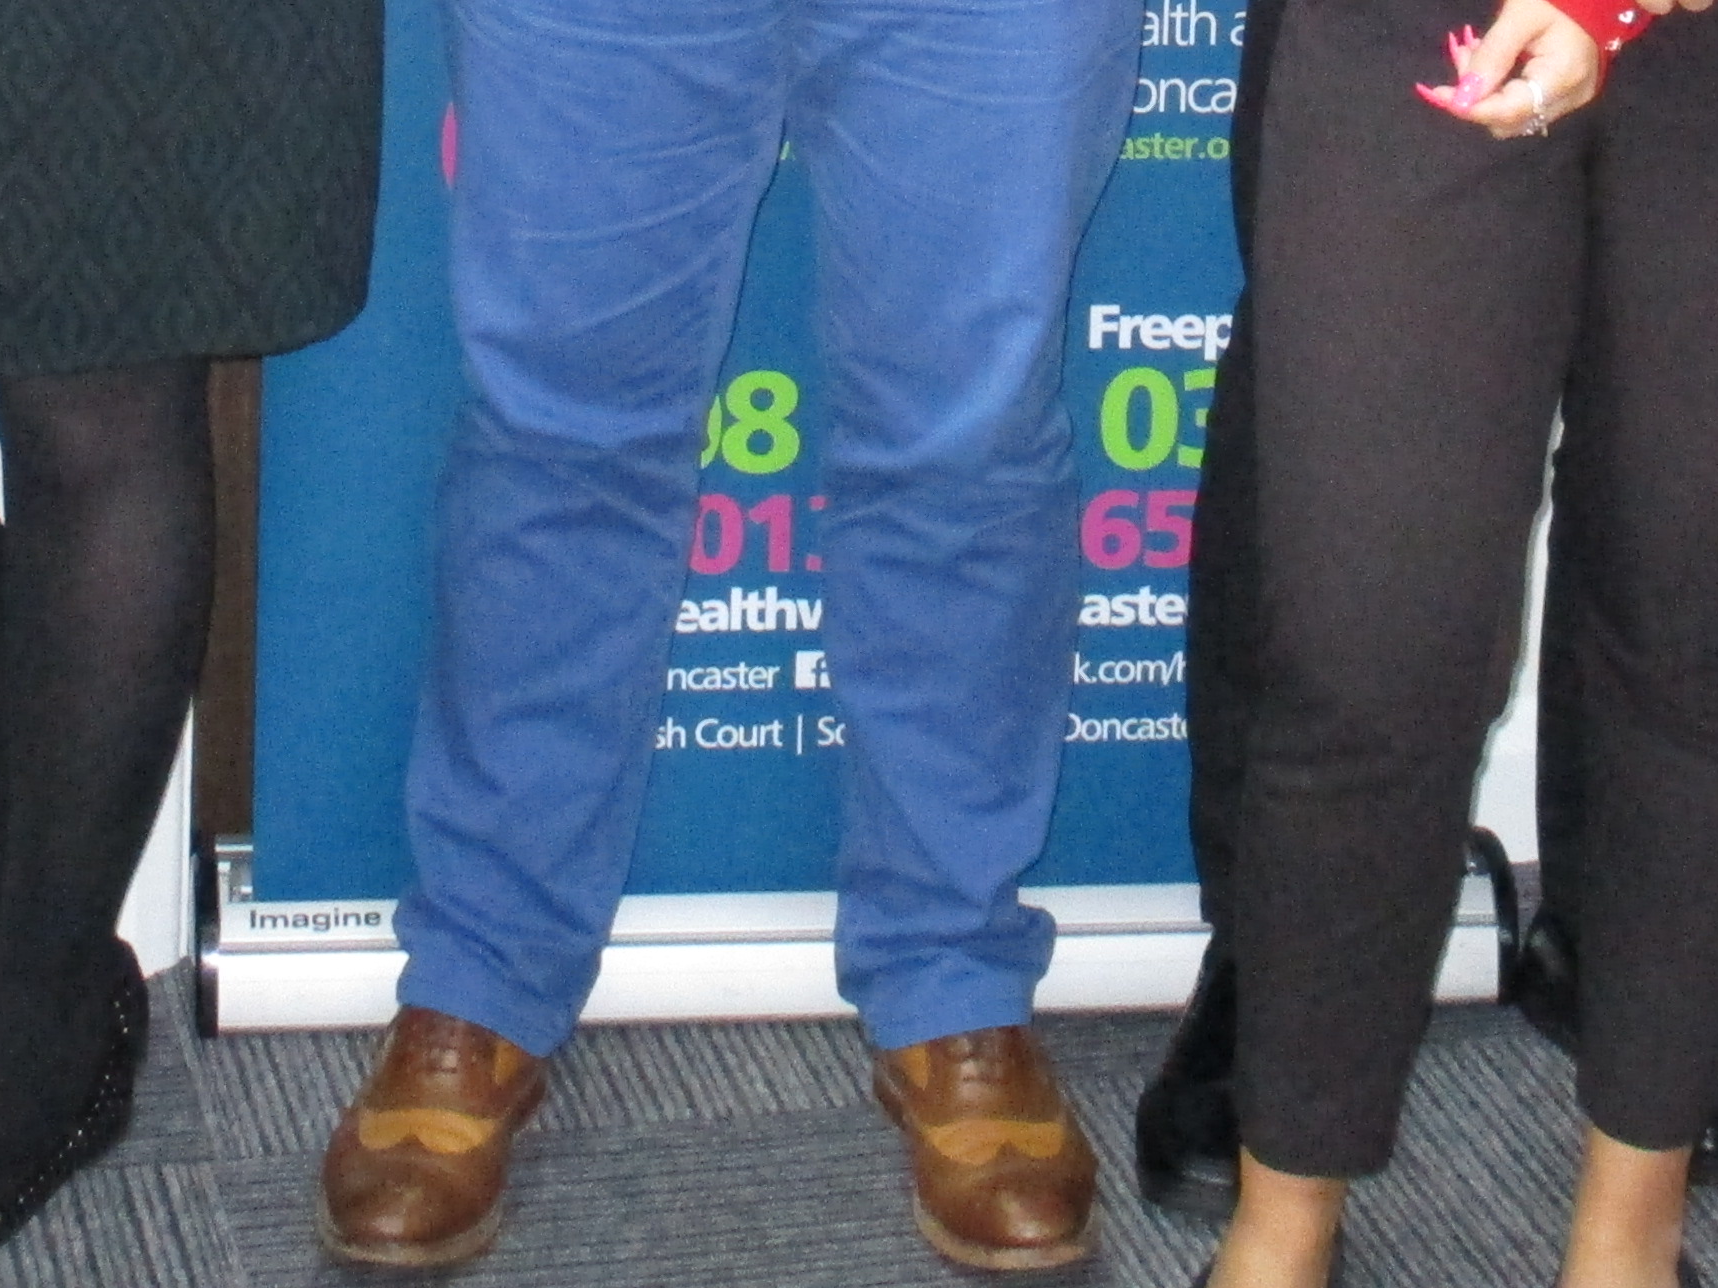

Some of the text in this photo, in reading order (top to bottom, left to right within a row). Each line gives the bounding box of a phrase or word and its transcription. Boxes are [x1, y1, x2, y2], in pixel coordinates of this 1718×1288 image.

[1088, 303, 1233, 361] Freep
[1080, 488, 1200, 571] 65
[666, 661, 781, 691] ncaster
[694, 717, 784, 749] Court
[249, 906, 382, 933] Imagine
